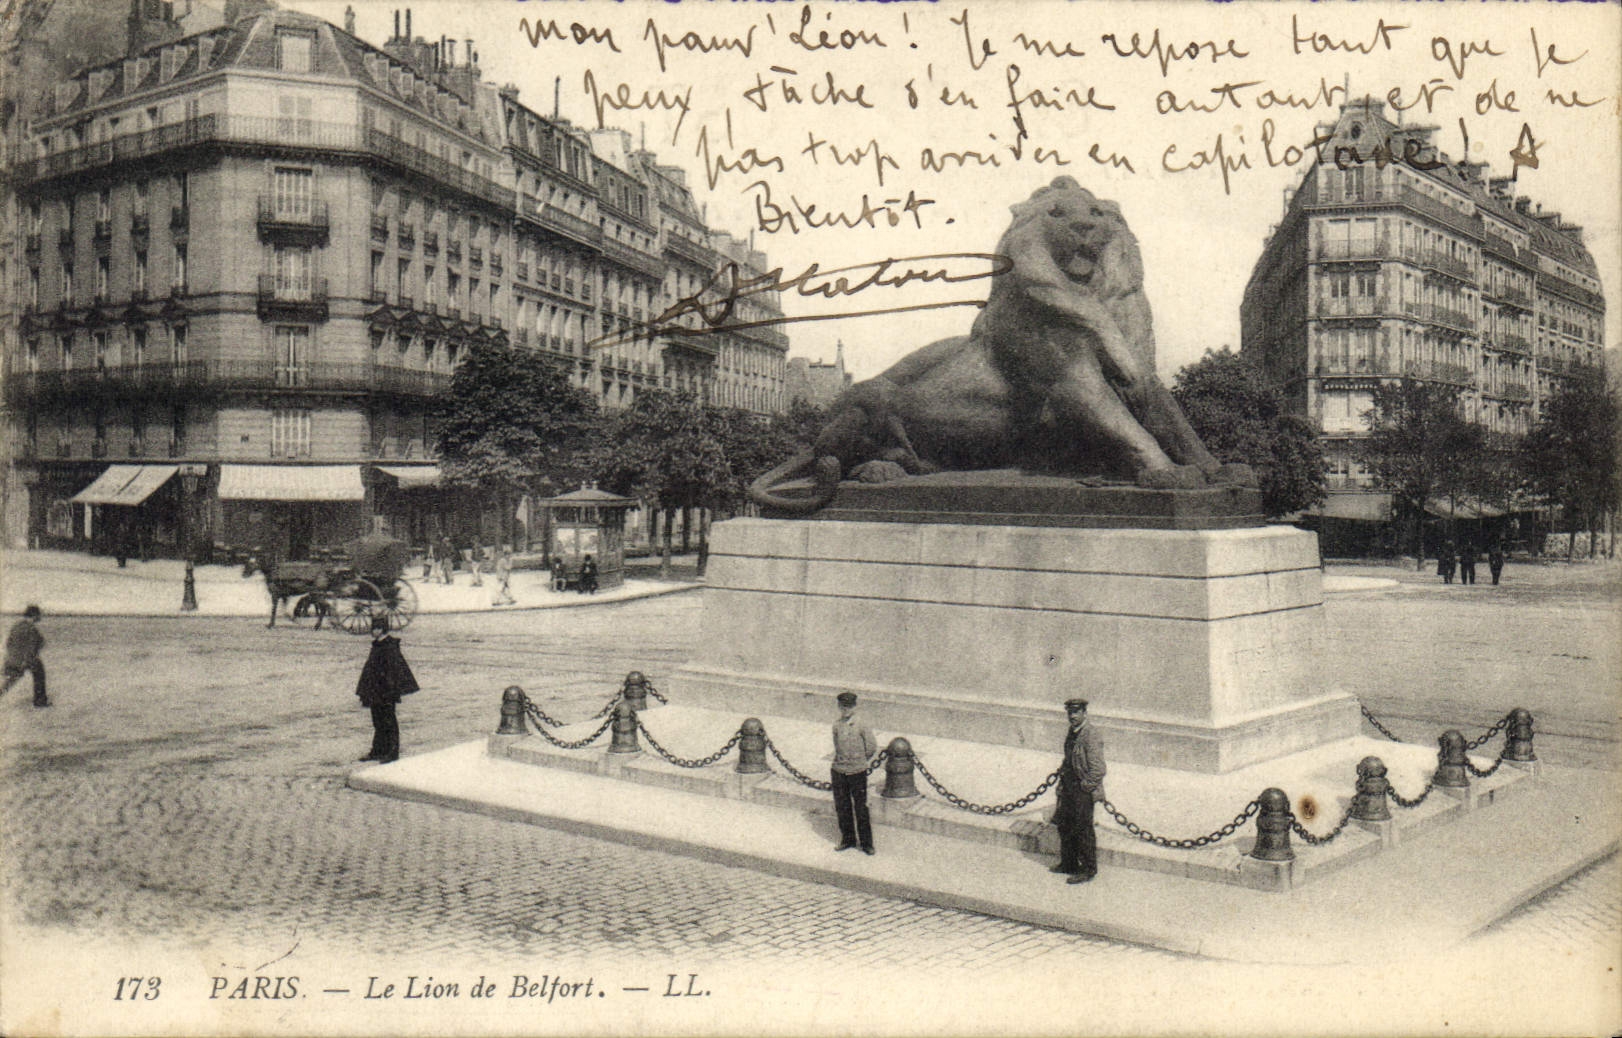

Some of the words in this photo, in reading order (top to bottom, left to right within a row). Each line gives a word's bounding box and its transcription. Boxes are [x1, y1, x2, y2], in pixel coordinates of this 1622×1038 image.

[519, 16, 621, 52] mon
[1013, 32, 1086, 58] me
[1102, 28, 1250, 77] repose
[1292, 14, 1410, 54] tant
[1431, 36, 1506, 79] que
[1006, 64, 1116, 138] faire
[1475, 77, 1521, 116] de
[801, 132, 900, 186] trop
[1088, 144, 1136, 173] en
